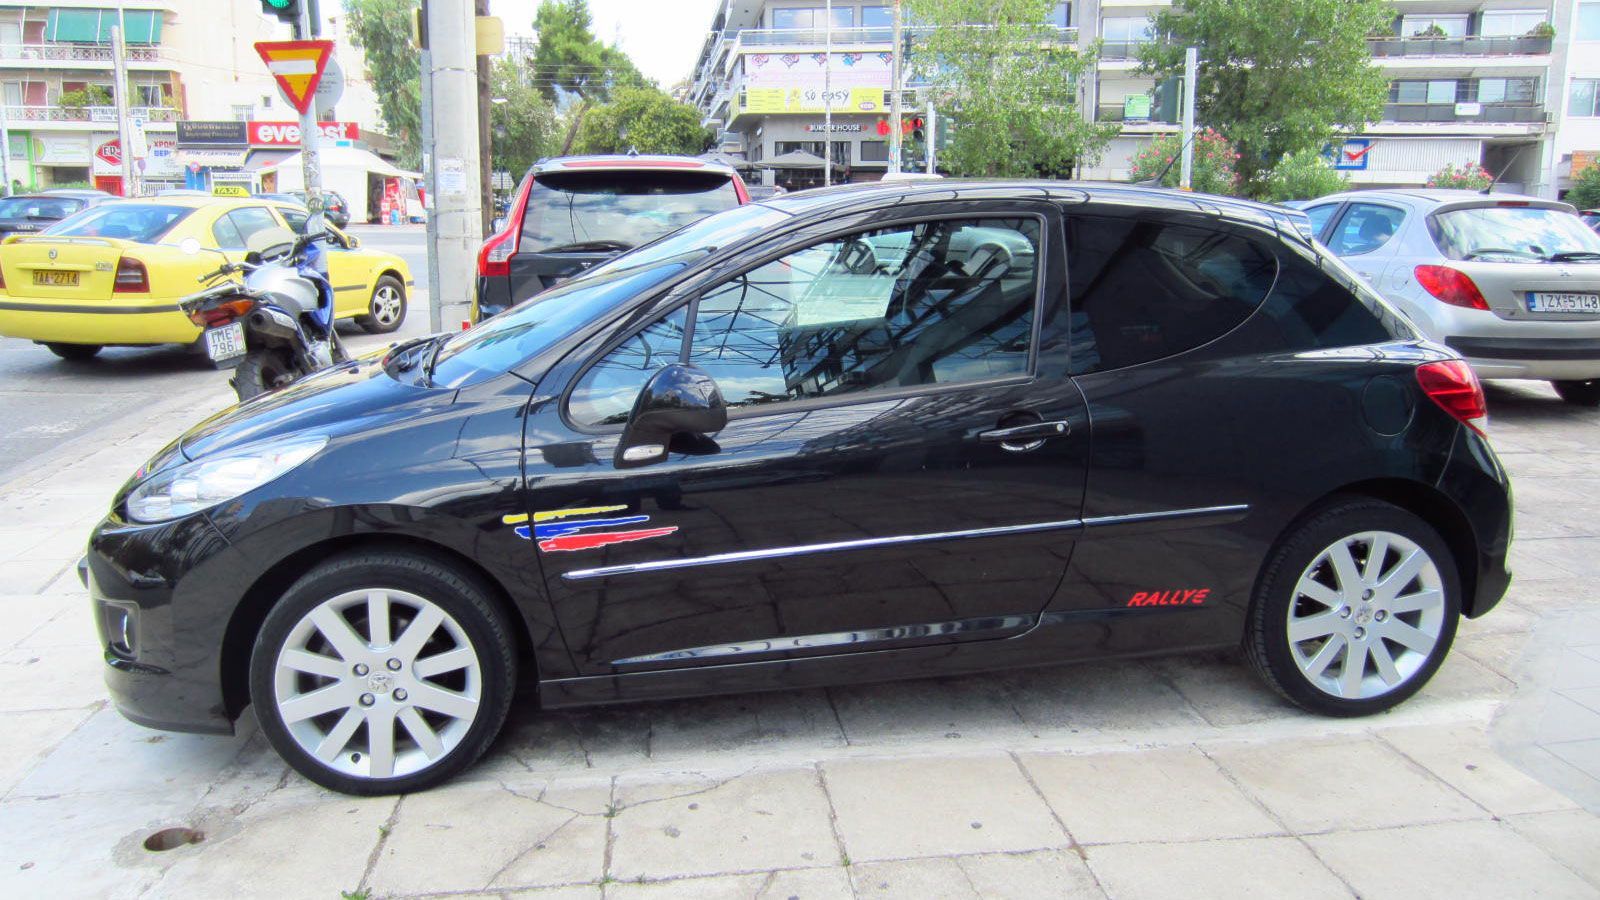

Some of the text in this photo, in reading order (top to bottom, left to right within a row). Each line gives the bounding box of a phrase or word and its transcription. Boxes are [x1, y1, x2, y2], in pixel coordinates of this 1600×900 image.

[258, 123, 347, 143] eveest
[216, 187, 239, 195] TAXI
[212, 340, 234, 358] 796
[1127, 588, 1210, 607] RALLYE
